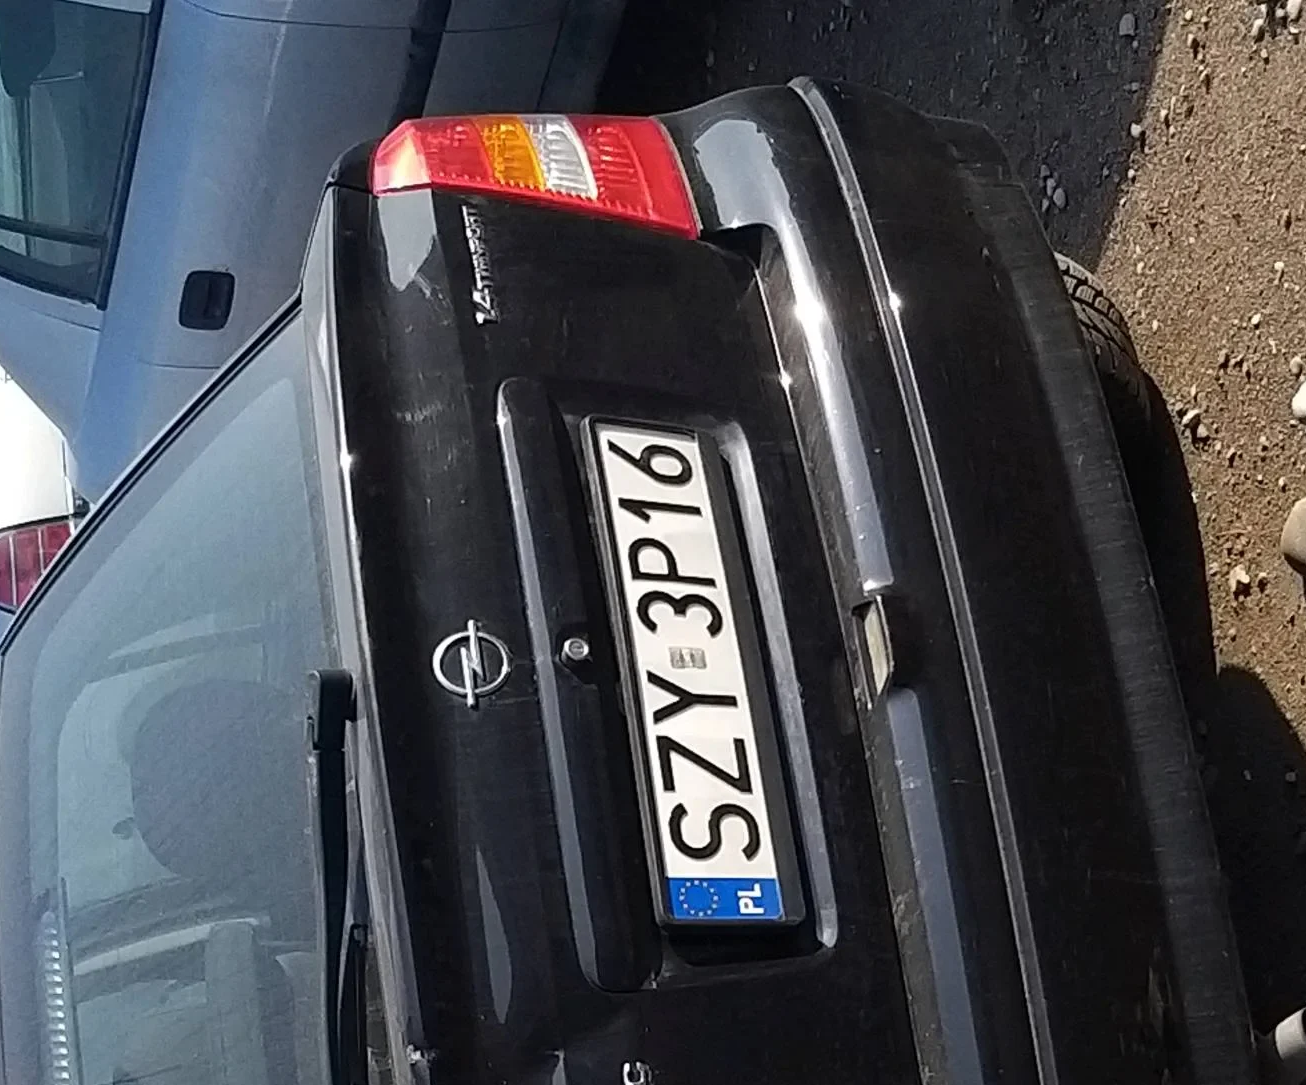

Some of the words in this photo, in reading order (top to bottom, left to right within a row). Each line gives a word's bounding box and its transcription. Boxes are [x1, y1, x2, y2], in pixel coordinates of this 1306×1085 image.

[607, 440, 724, 639] 3P16
[646, 670, 762, 862] SZY
[736, 882, 765, 915] PL
